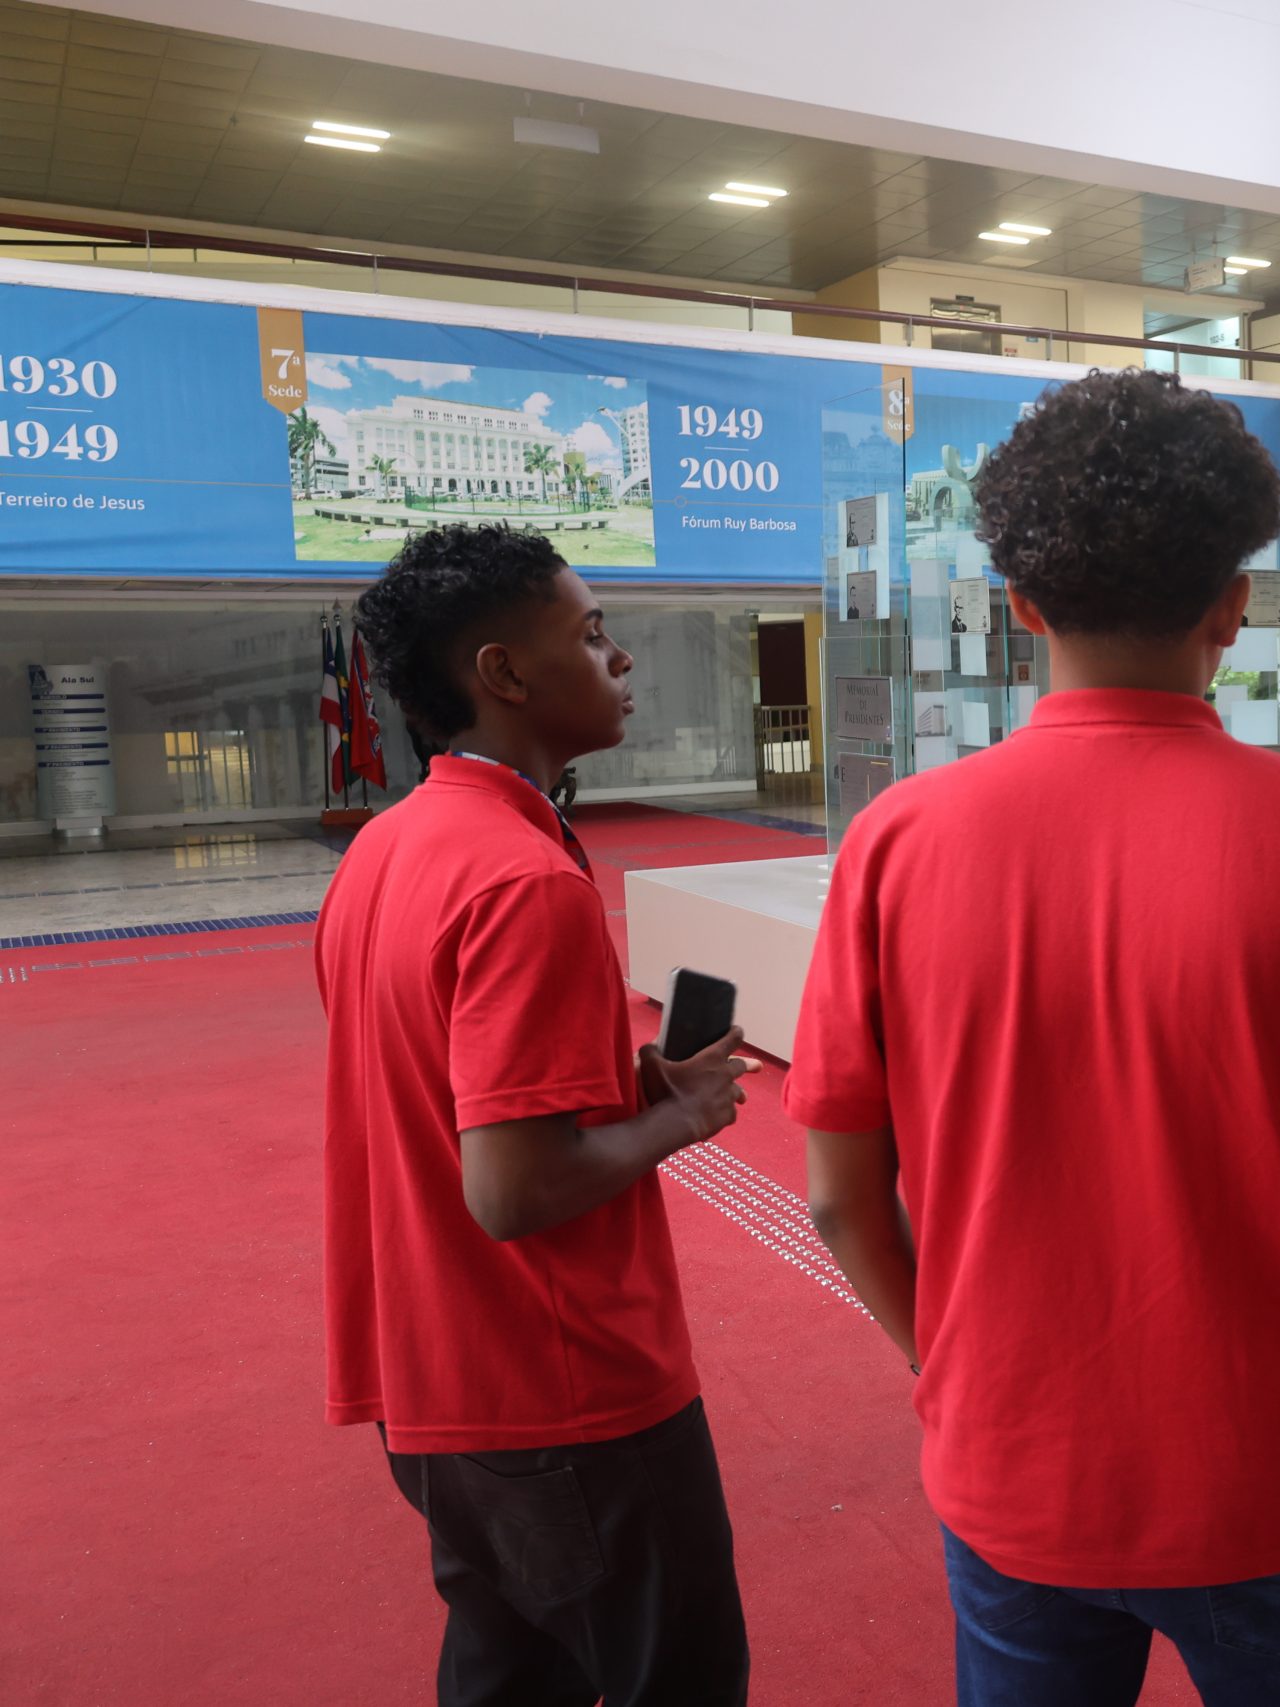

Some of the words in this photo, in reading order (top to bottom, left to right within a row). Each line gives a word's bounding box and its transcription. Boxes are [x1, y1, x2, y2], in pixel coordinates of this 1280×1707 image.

[268, 384, 303, 398] Sede
[677, 405, 764, 440] 1949
[0, 420, 118, 463] 1949
[679, 457, 780, 493] 2000
[72, 494, 95, 508] de
[99, 496, 146, 510] Jesus
[682, 515, 721, 530] Fórum
[724, 517, 746, 532] Ruy
[749, 518, 797, 532] Barbosa
